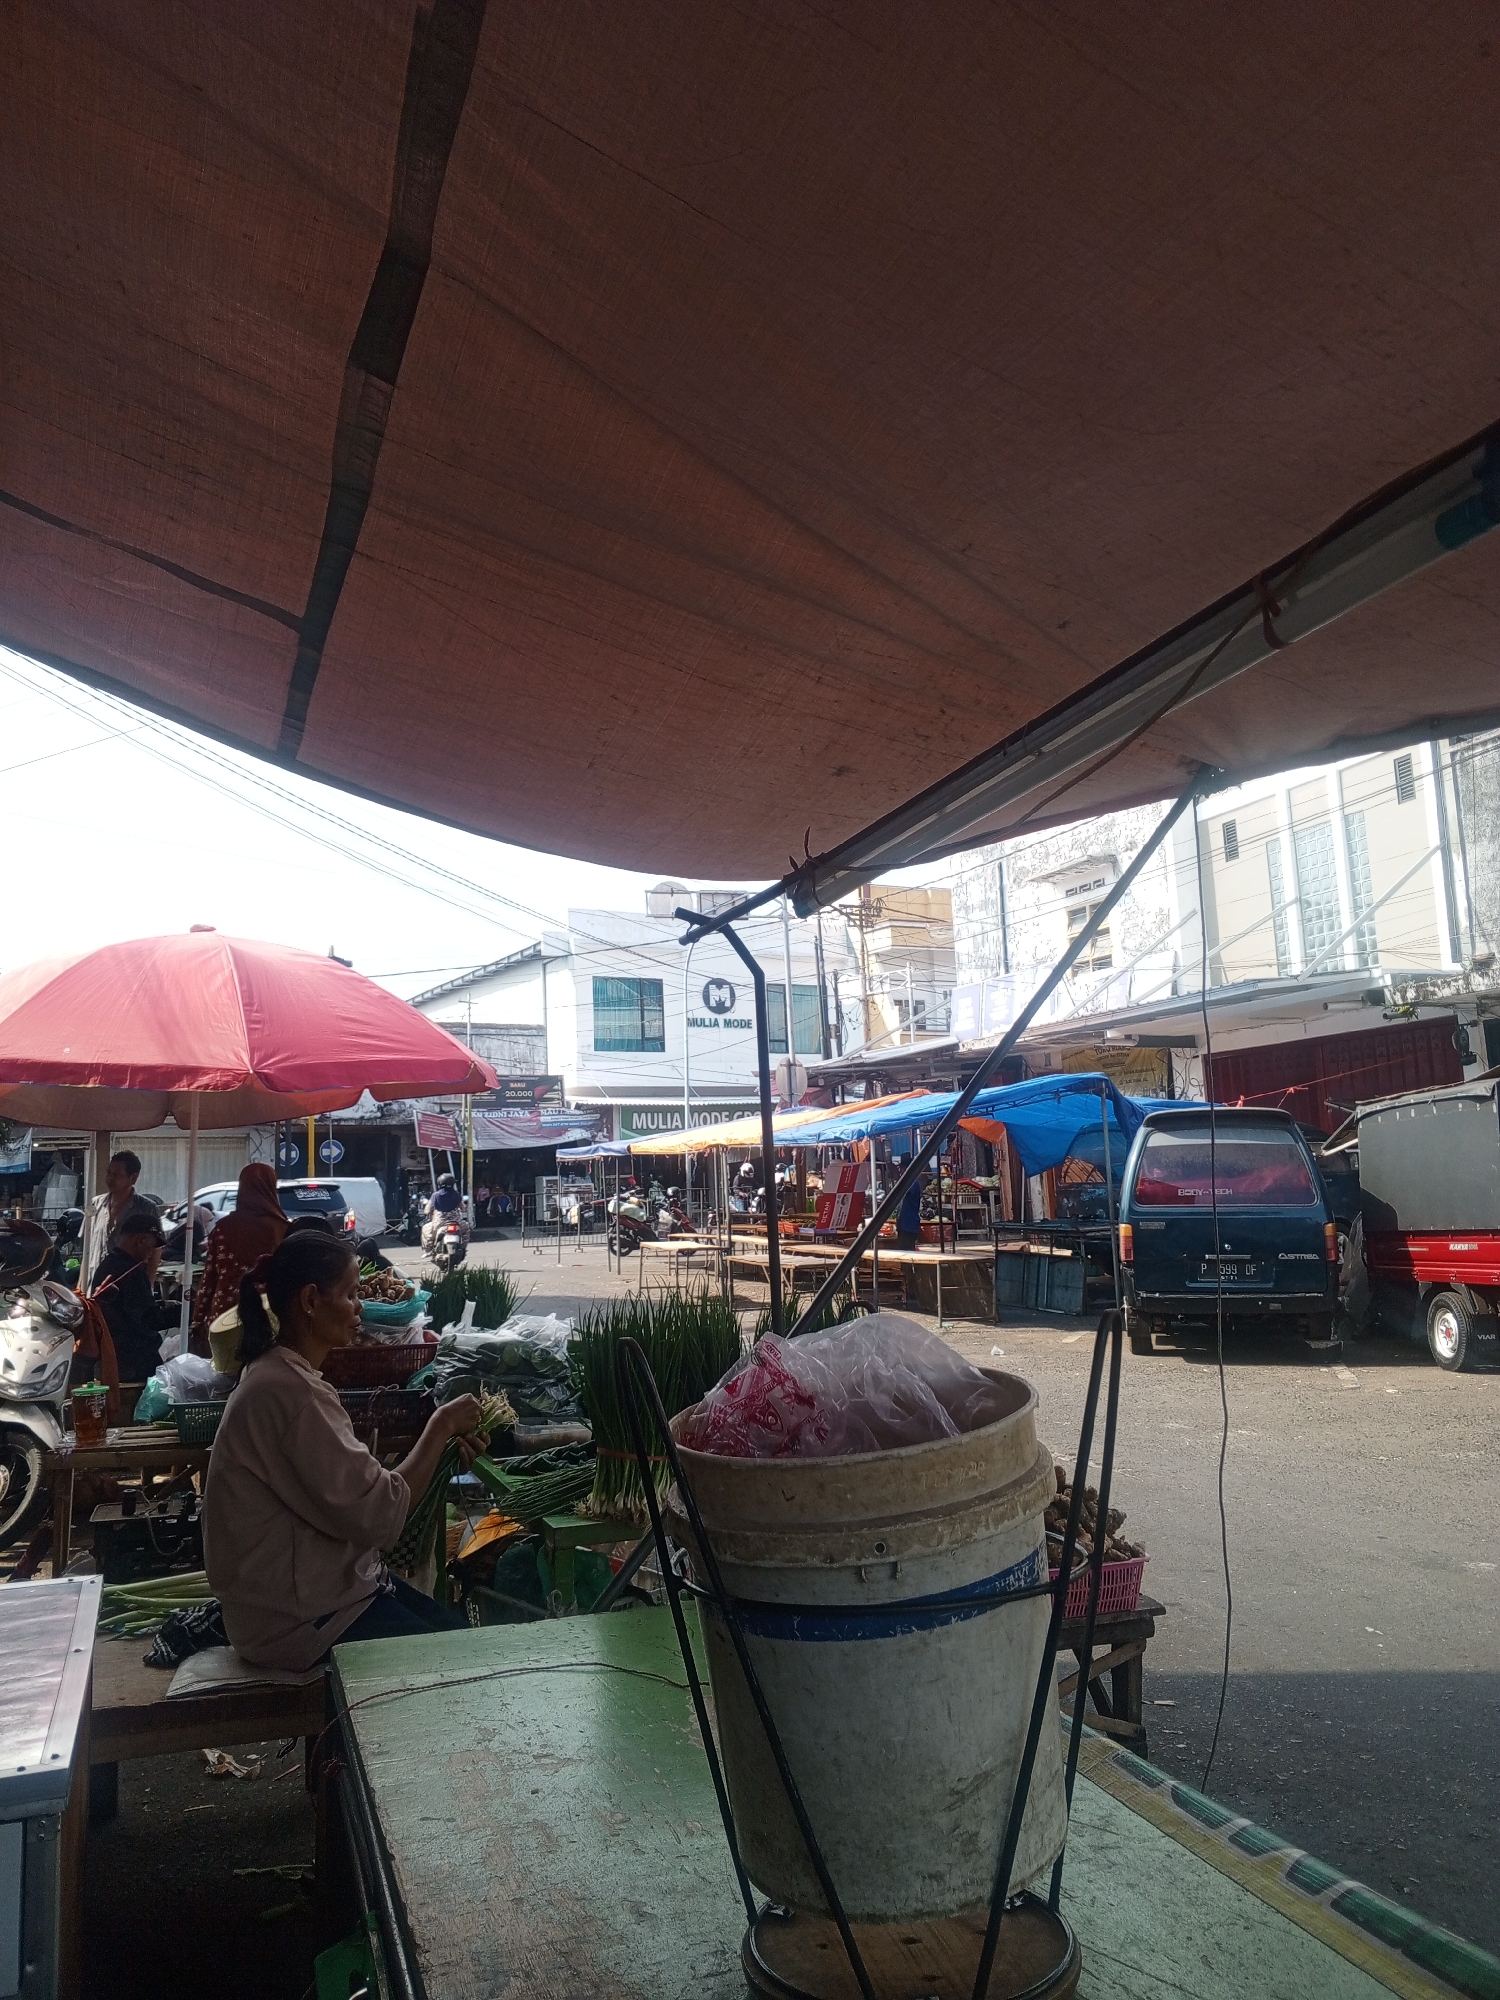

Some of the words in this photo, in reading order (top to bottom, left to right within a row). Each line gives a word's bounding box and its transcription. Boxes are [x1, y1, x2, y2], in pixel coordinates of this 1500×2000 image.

[687, 1017, 720, 1028] MULIA
[723, 1018, 753, 1029] MODE
[505, 1090, 533, 1098] 20.000
[508, 1110, 531, 1118] JAYA
[632, 1112, 683, 1130] MULIA
[687, 1110, 731, 1128] MODE
[1201, 1263, 1208, 1275] P
